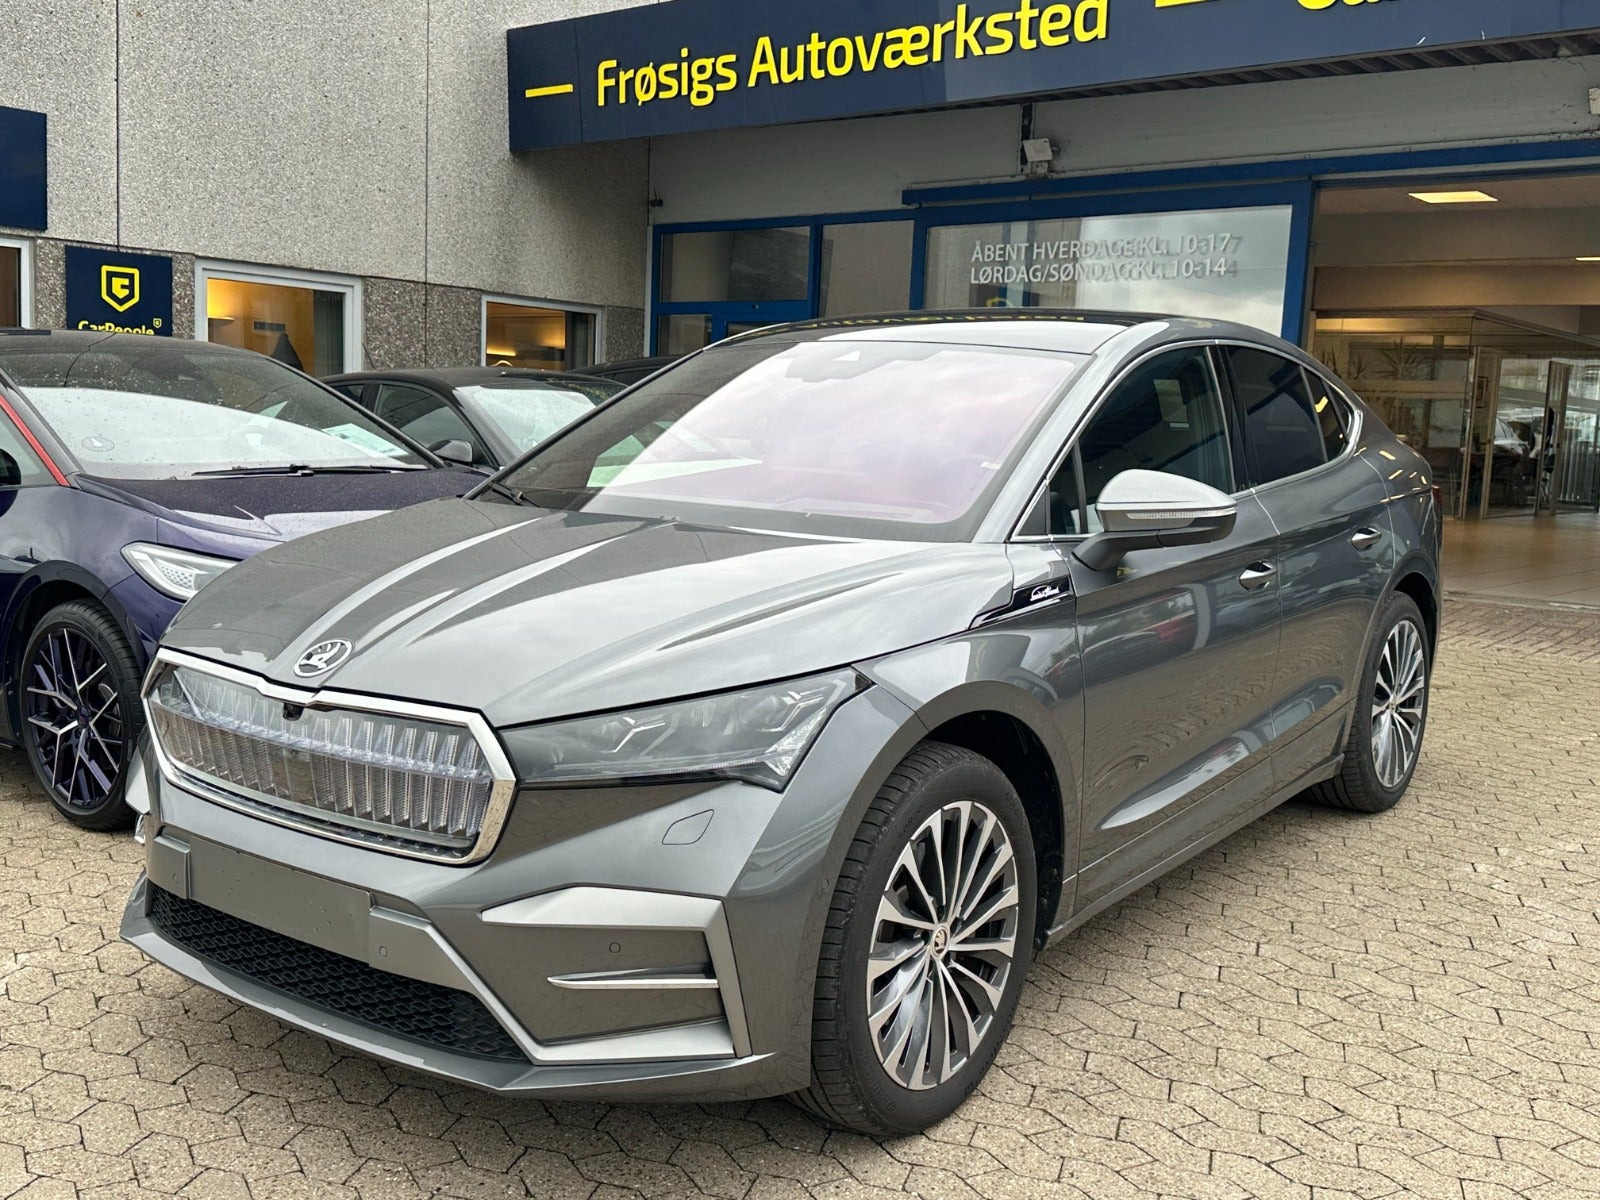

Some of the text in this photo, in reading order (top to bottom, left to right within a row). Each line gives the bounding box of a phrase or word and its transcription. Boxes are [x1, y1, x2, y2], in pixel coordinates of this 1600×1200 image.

[597, 0, 1108, 107] Frøsigs Autoværksted
[971, 241, 1029, 262] ÅBENT
[1033, 238, 1135, 260] HVERDAGE
[1178, 232, 1232, 253] 10-17
[1170, 257, 1227, 277] 10-14
